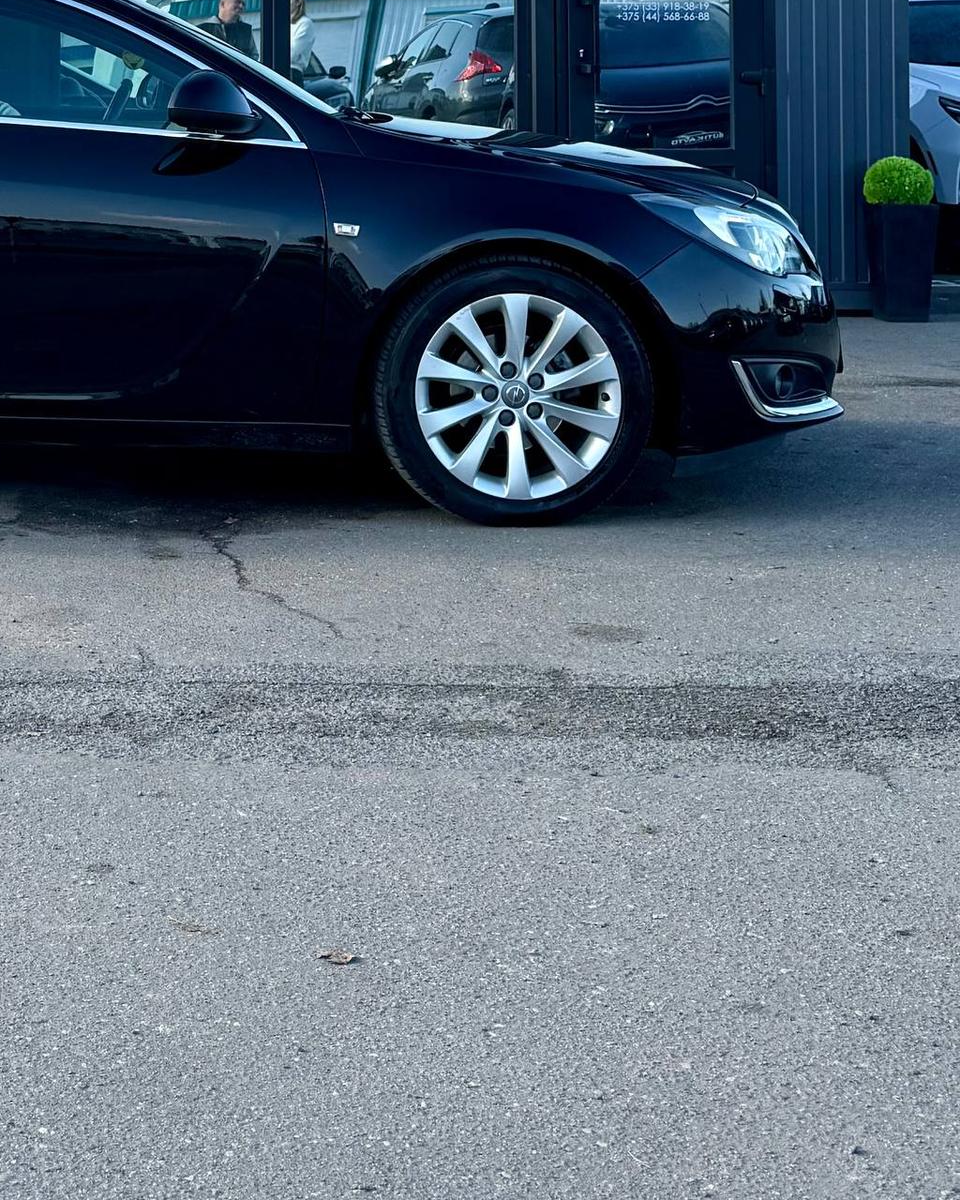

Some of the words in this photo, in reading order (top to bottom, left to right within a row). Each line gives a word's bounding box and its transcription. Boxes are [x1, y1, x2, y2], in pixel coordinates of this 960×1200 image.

[616, 2, 640, 11] +375
[642, 1, 661, 12] (33)
[663, 1, 710, 11] 918-38-19
[616, 11, 640, 21] +375
[642, 11, 661, 23] (44)
[663, 11, 710, 21] 568-66-88
